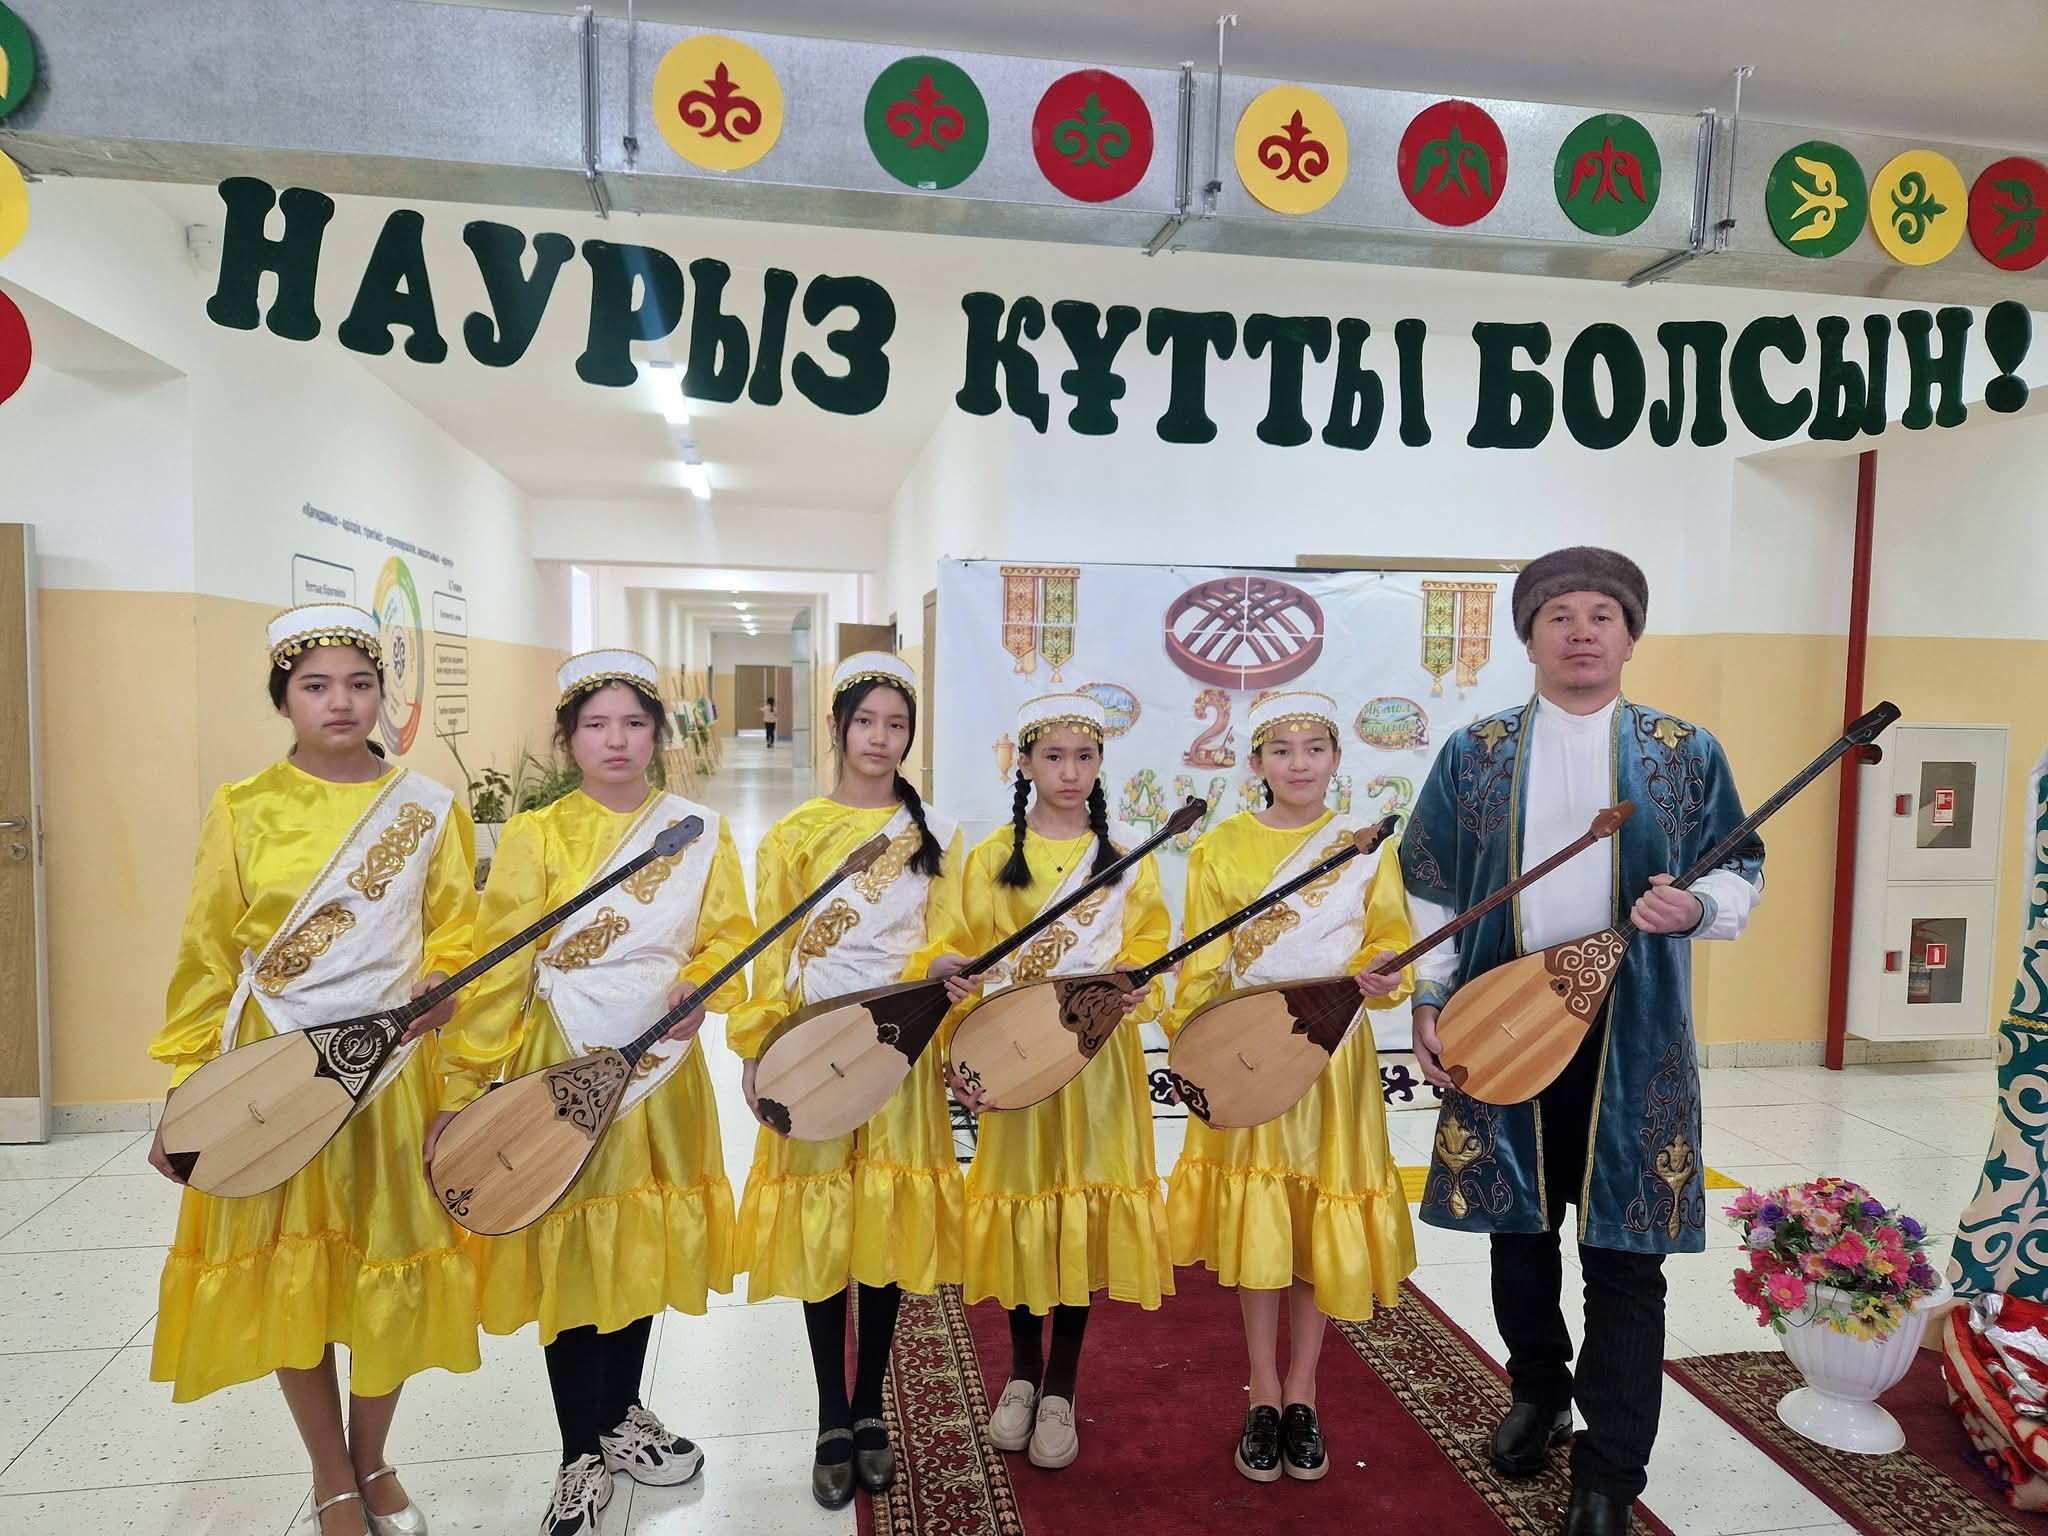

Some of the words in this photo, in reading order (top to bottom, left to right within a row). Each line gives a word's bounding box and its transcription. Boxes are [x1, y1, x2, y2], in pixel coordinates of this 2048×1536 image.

[206, 176, 897, 416] НАУРЫЗ
[956, 291, 1432, 450] ҚҰТТЫ
[1466, 300, 2031, 450] БОЛСЫН!
